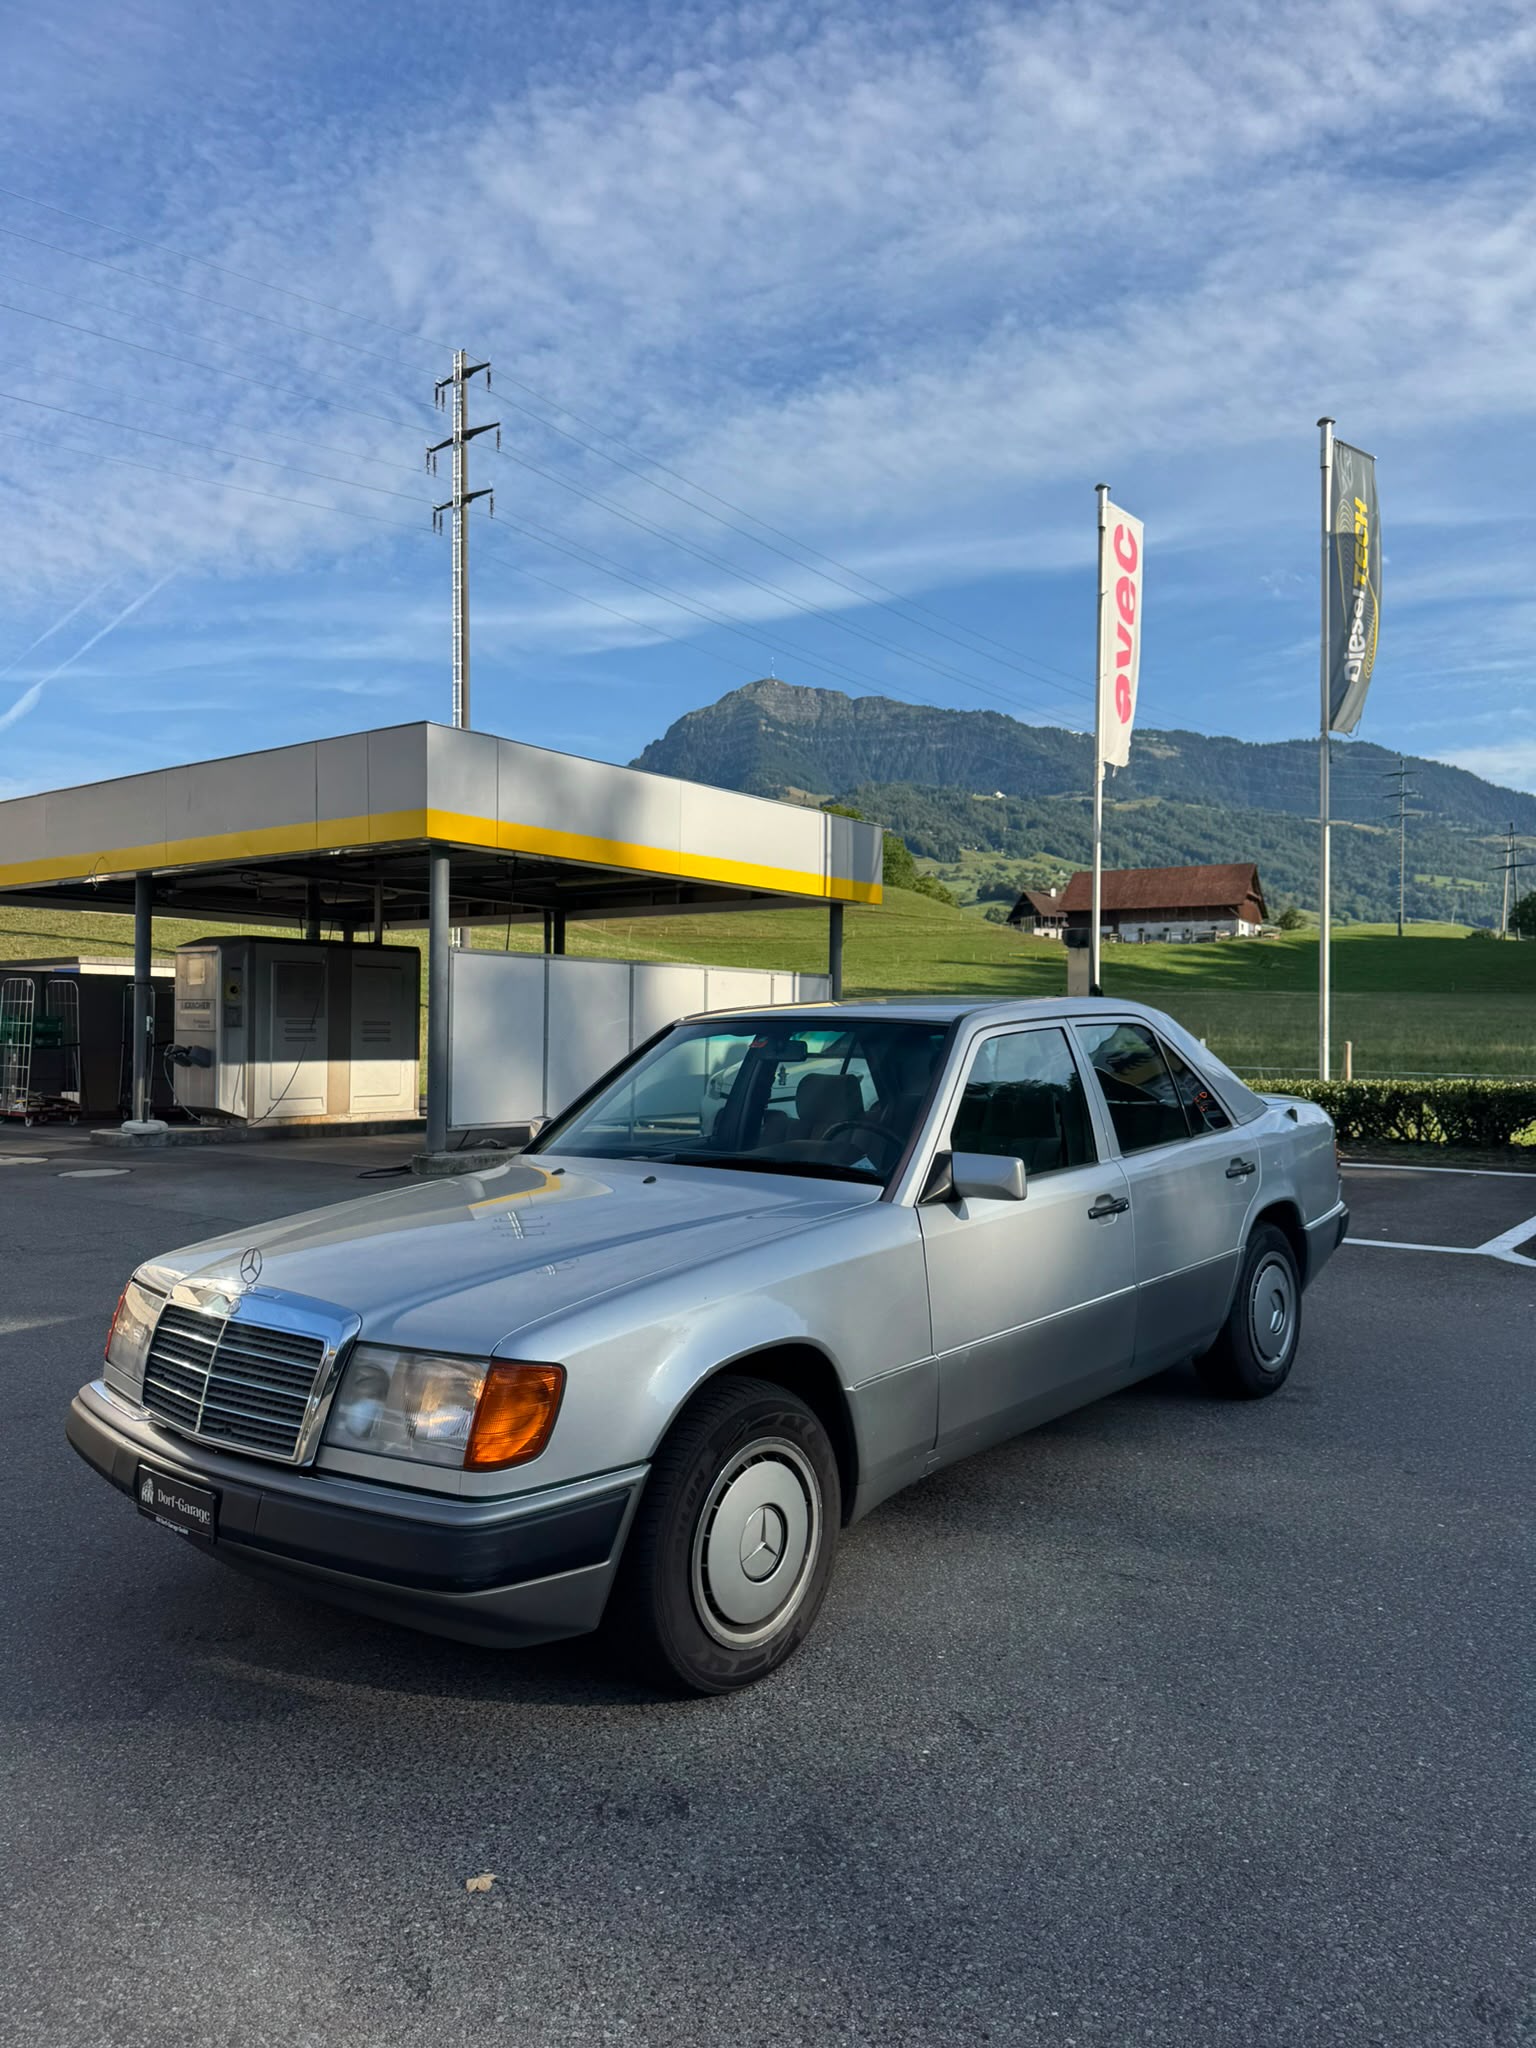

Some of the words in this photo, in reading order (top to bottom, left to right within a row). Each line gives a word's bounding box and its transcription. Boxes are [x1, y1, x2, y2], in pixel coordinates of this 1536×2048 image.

[1113, 523, 1138, 724] avec
[1344, 497, 1369, 683] DieselTECH
[157, 1488, 211, 1524] Dorf-Garage
